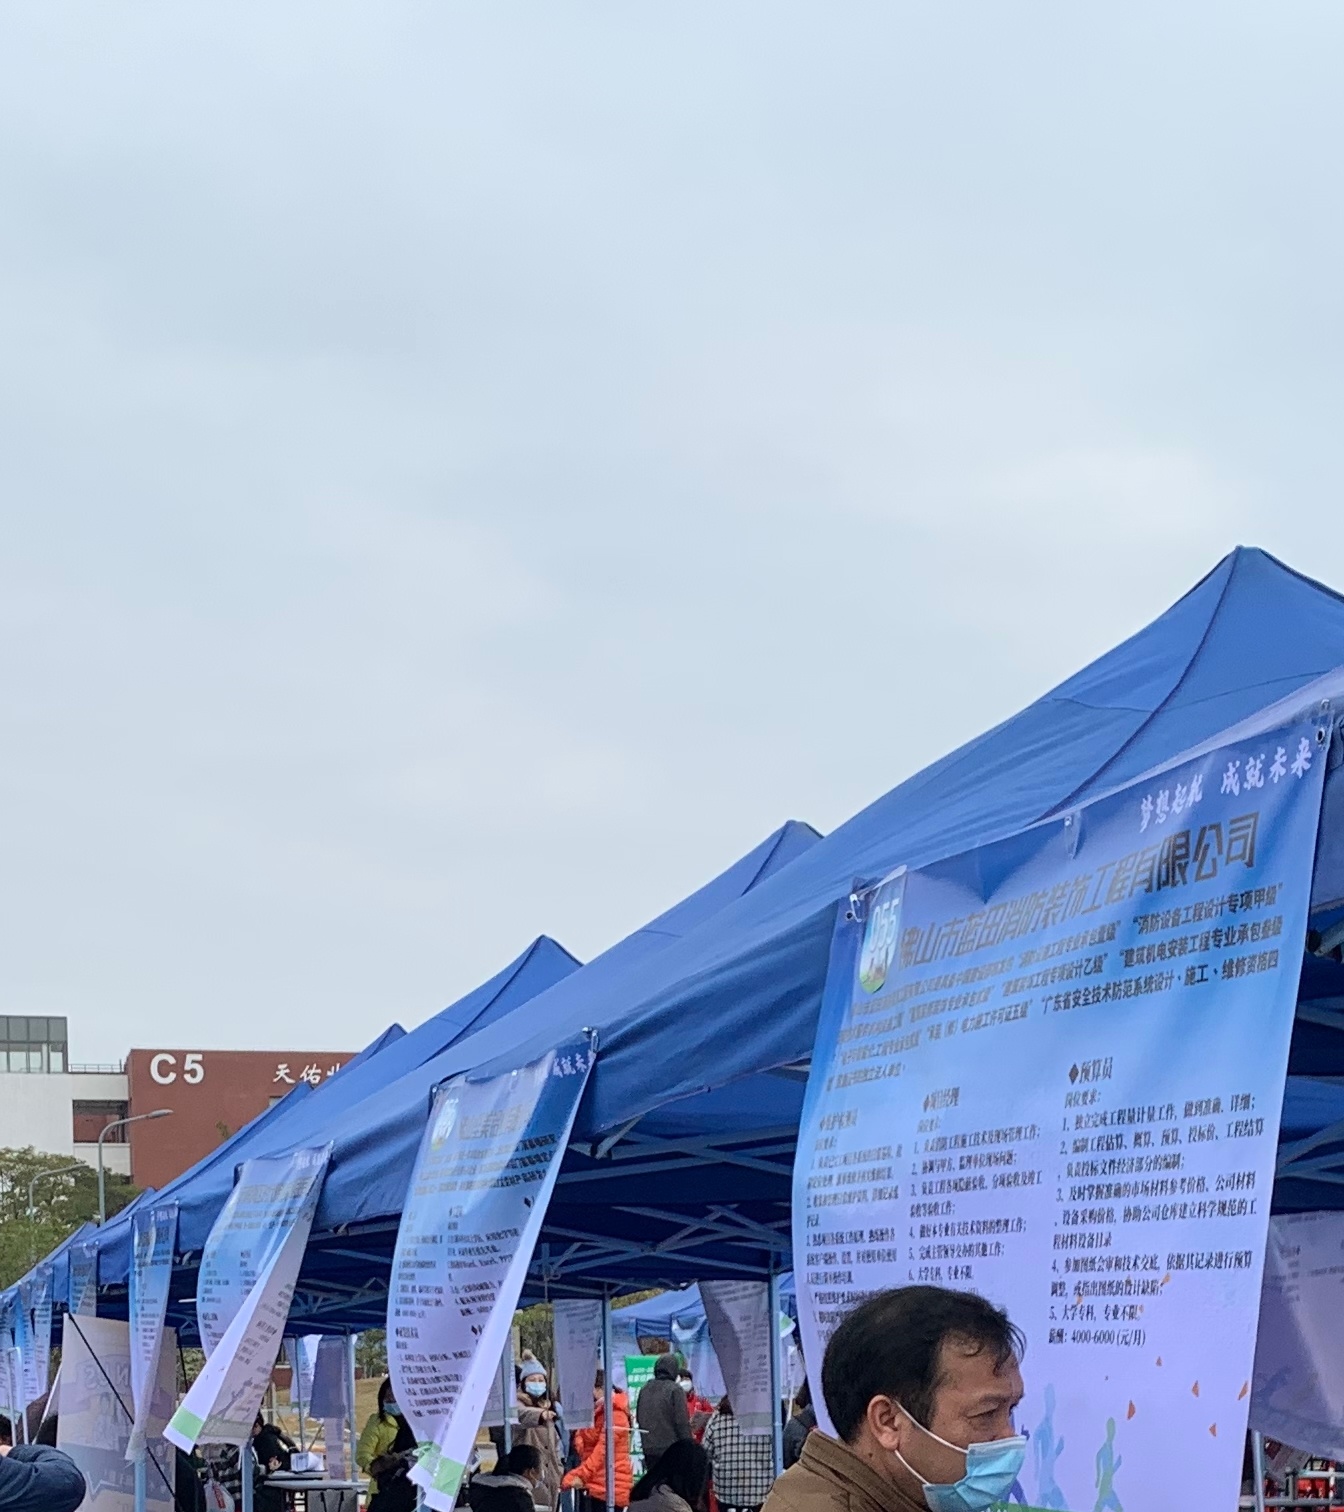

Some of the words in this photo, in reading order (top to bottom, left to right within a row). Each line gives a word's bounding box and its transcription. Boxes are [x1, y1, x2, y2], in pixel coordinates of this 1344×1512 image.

[1221, 737, 1312, 796] 成就未来
[150, 1053, 204, 1085] C5
[1079, 1057, 1113, 1084] 预算员
